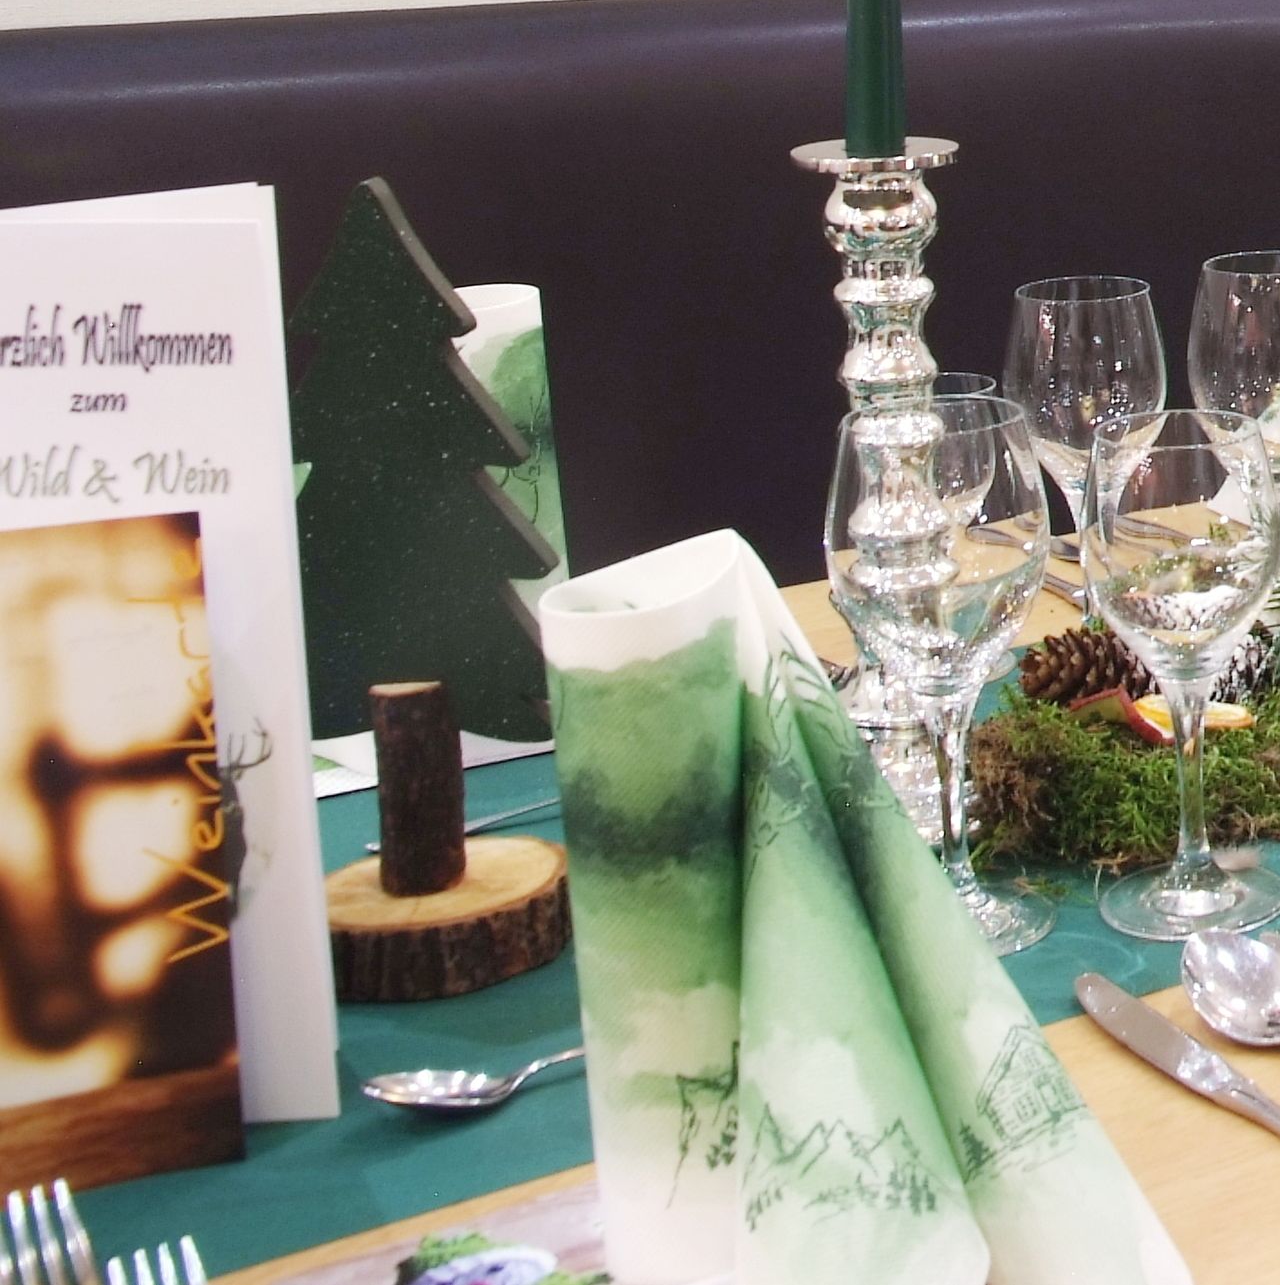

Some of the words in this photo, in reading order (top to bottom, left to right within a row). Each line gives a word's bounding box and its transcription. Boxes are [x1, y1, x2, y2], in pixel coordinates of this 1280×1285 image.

[0, 304, 64, 367] rzlich
[72, 303, 232, 373] Willkommen
[69, 393, 126, 412] zum
[83, 459, 120, 503] &
[133, 449, 230, 494] Wein
